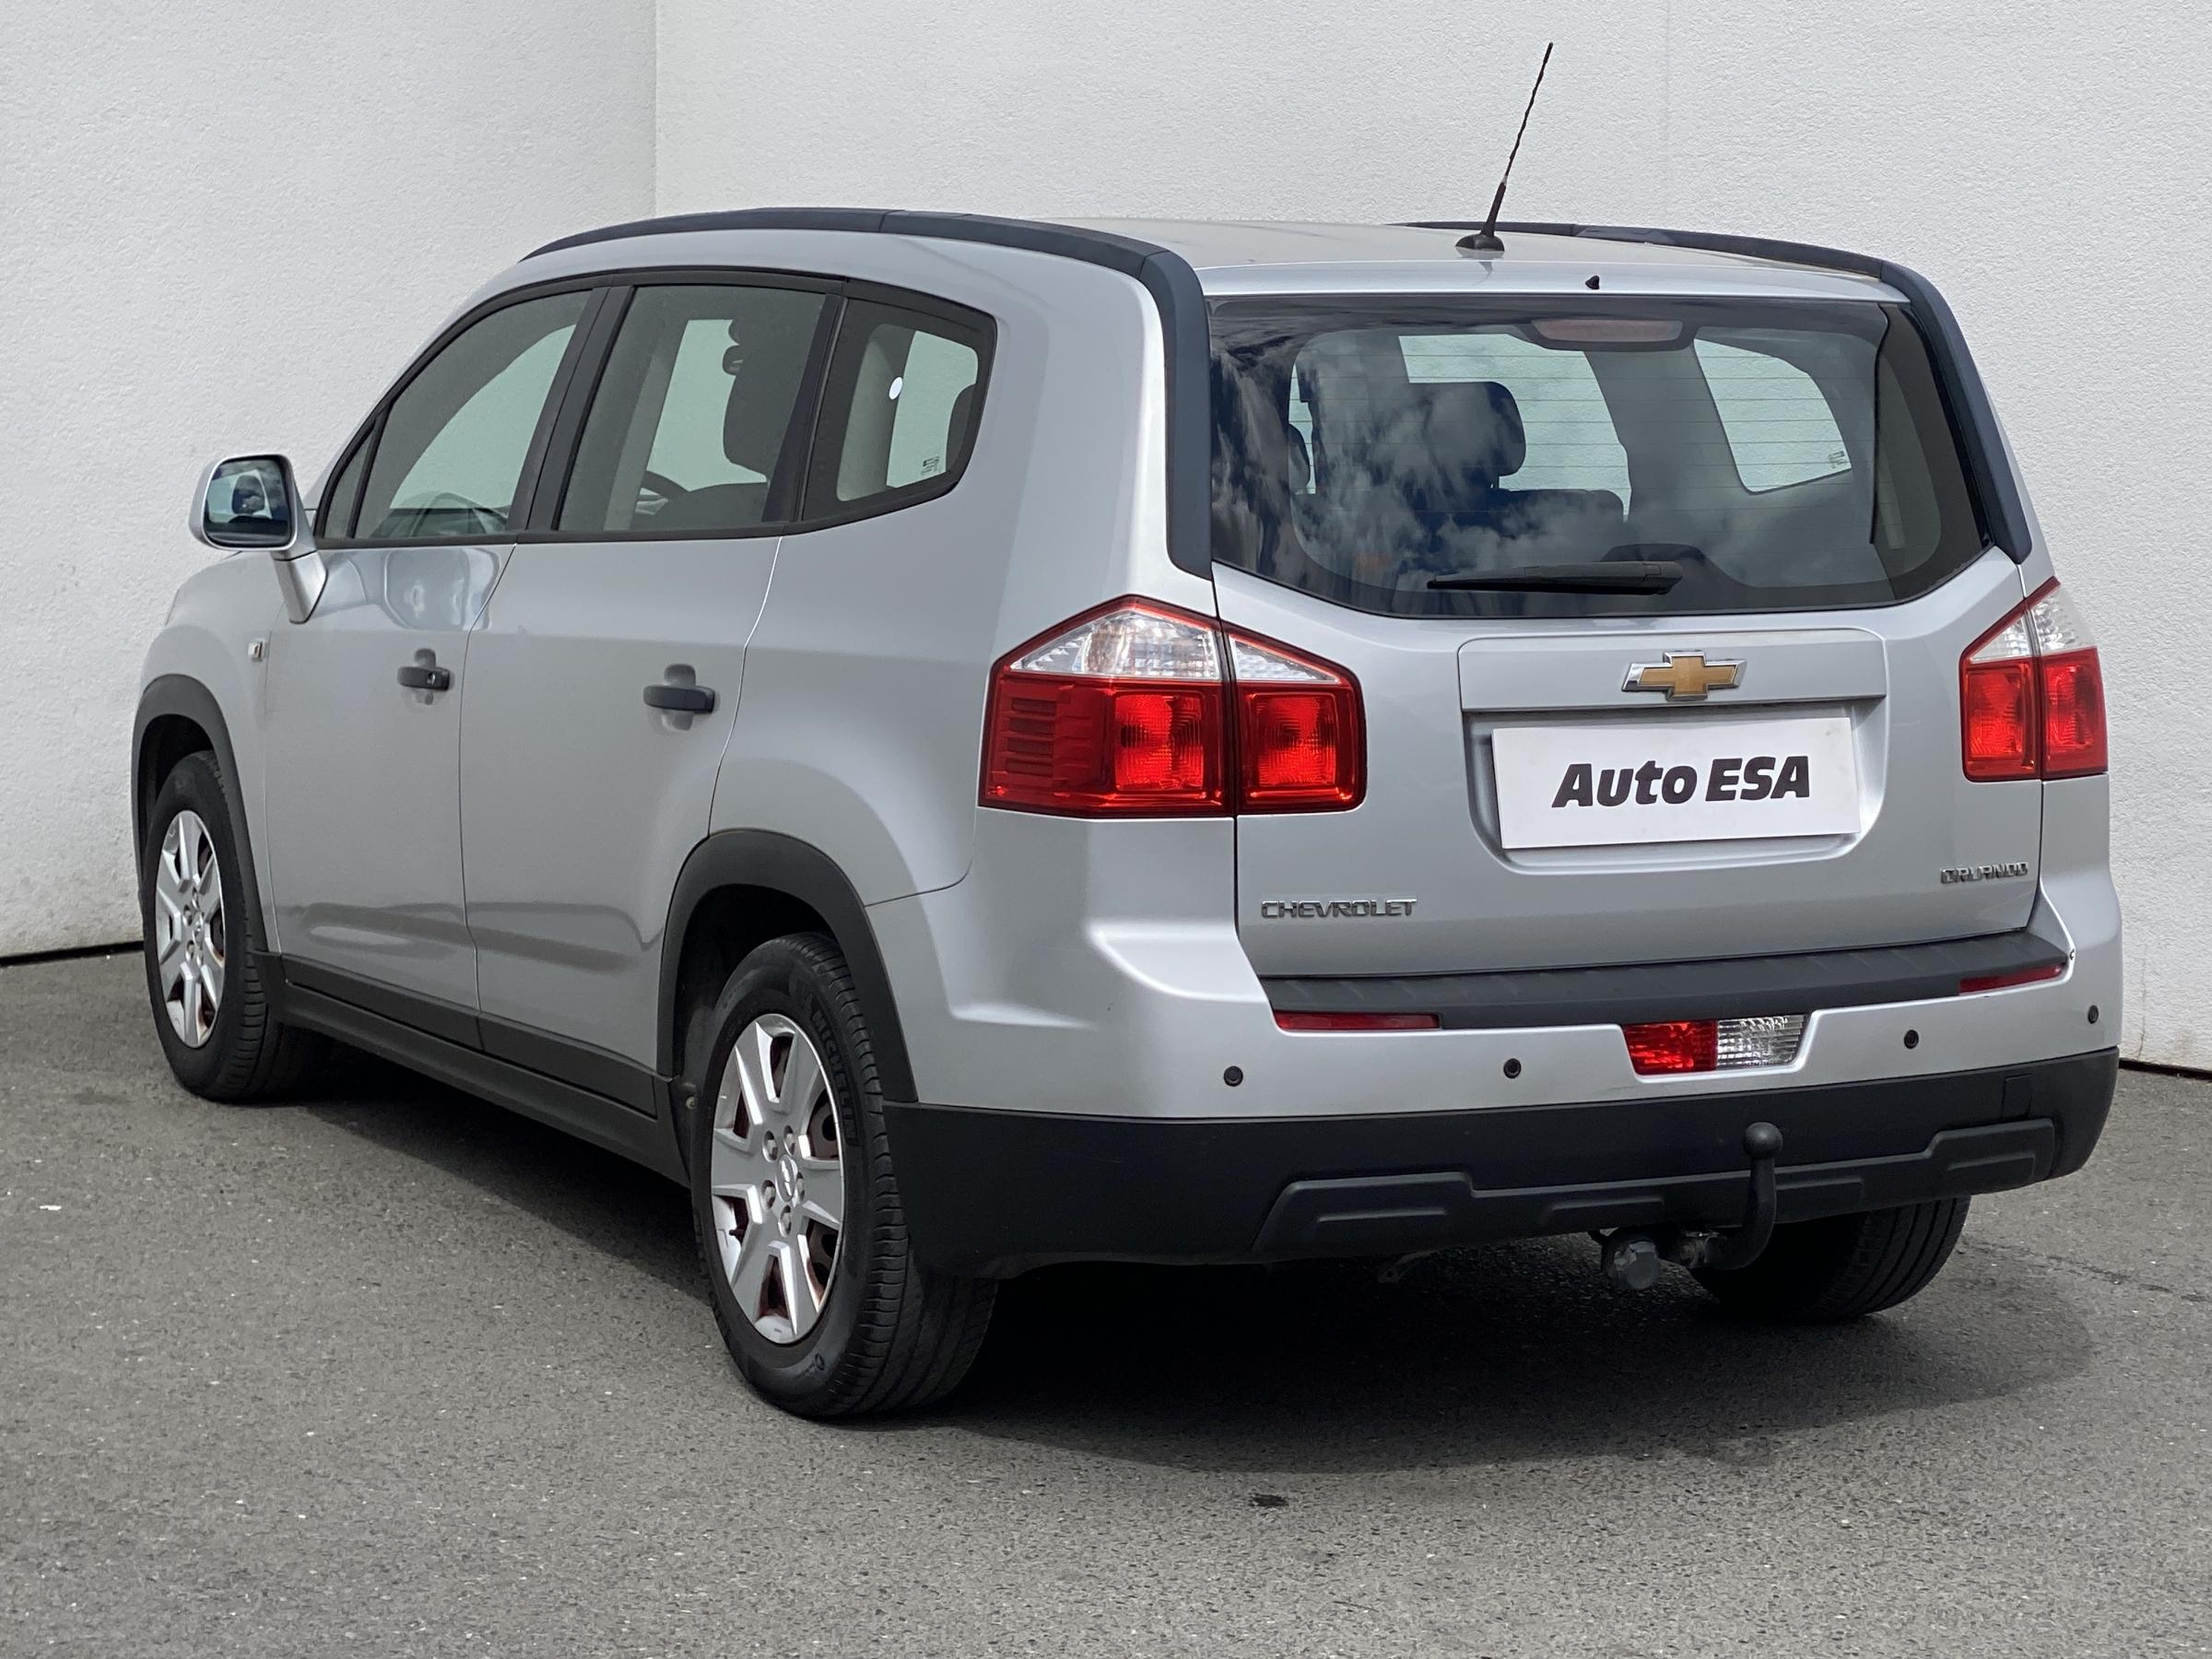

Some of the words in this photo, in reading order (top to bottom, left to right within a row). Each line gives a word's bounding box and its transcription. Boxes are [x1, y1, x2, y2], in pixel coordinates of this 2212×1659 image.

[1551, 760, 1697, 808] Auto
[1705, 756, 1809, 802] ESA
[1940, 862, 2029, 884] ORLANDO
[1261, 899, 1418, 918] CHEVROLET
[812, 1009, 856, 1139] MICHELIN
